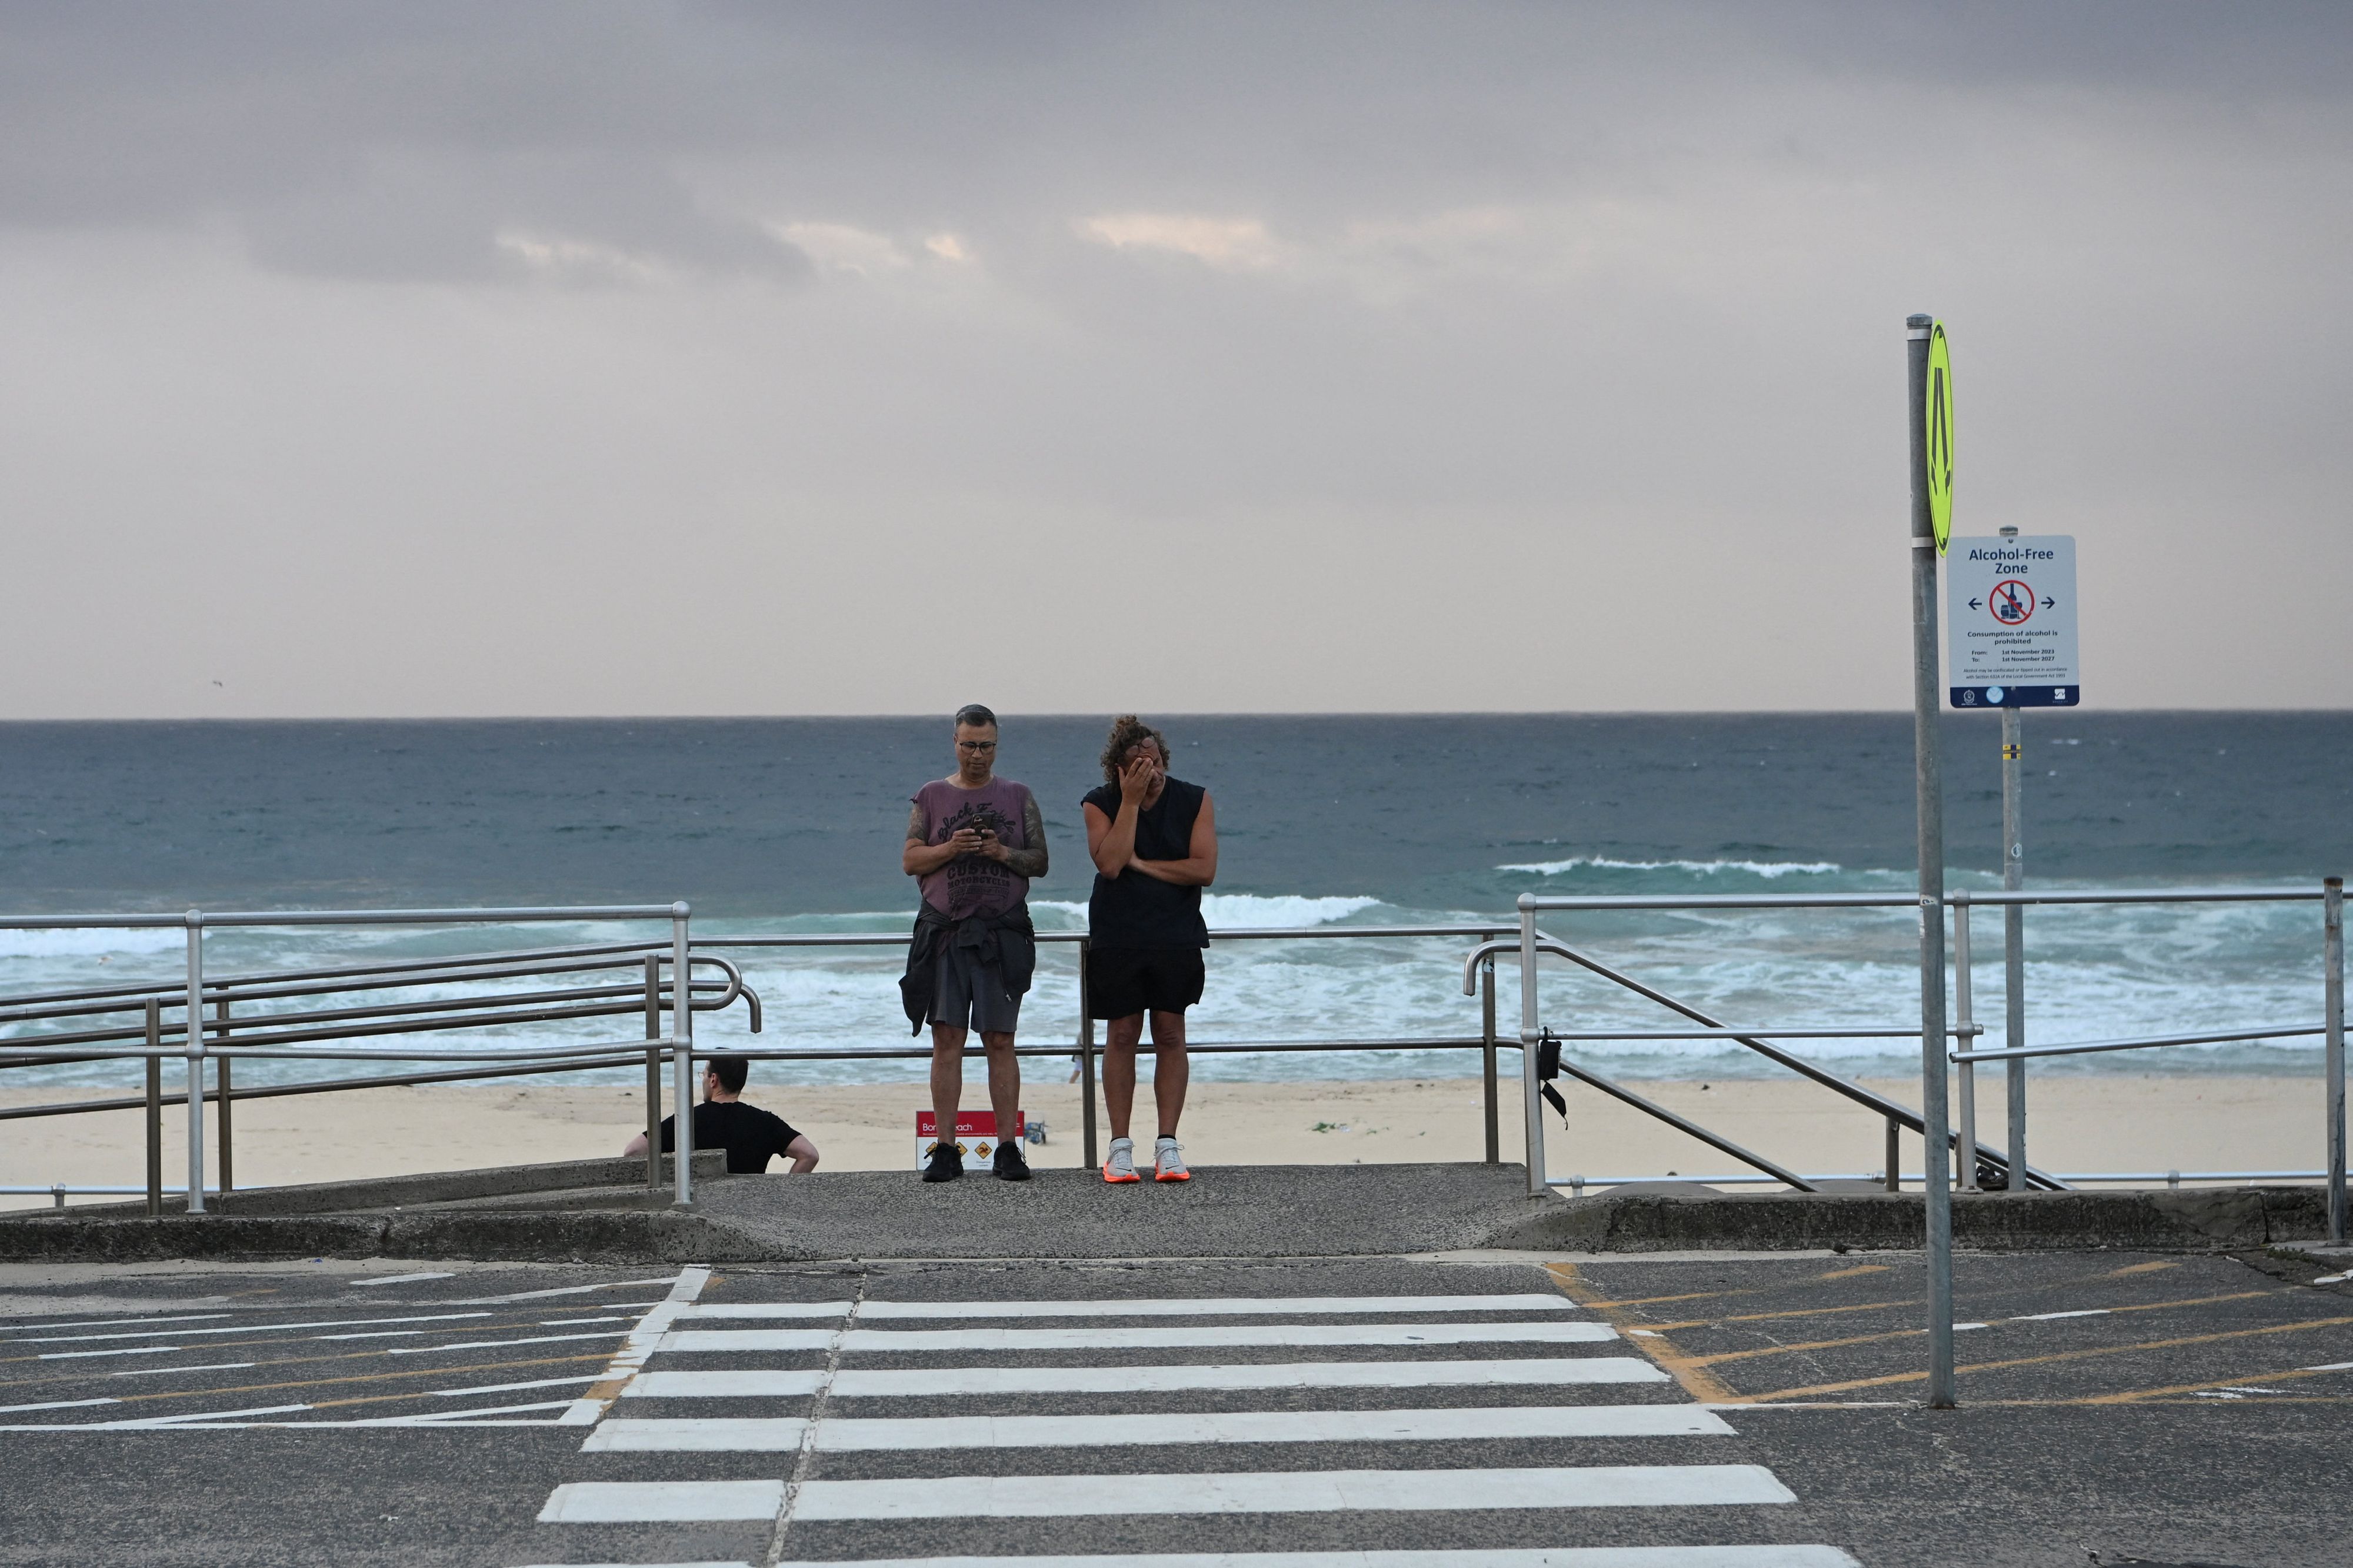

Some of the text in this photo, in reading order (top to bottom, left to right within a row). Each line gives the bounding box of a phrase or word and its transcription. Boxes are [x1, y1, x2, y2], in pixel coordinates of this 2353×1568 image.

[1969, 548, 2054, 561] Alcohol-Free
[1995, 563, 2028, 574] Zone
[947, 862, 1009, 879] CUSTOM
[948, 876, 1010, 889] MOTORCYCLES
